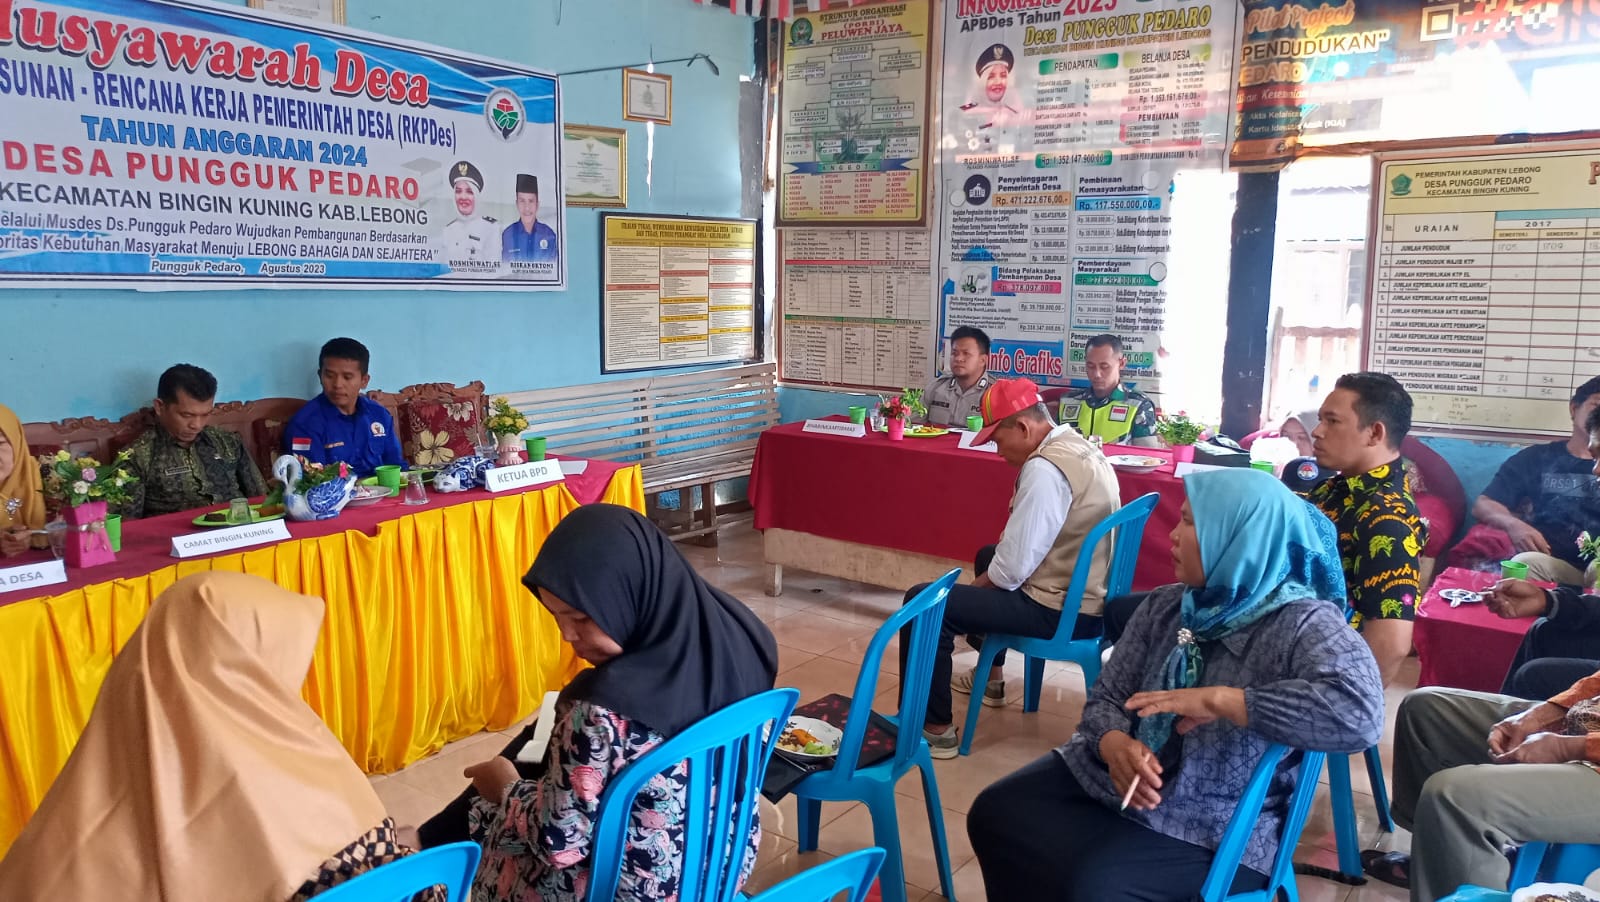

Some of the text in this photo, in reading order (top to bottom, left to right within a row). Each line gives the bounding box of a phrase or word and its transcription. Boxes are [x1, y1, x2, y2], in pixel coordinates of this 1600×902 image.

[820, 9, 858, 21] STRUKTUR
[859, 4, 906, 17] ORGANISASI
[1248, 1, 1355, 36] Pilot Project
[960, 11, 1061, 33] APBDes Tahun
[1024, 5, 1212, 46] Desa PUNGGUK PEDARO
[821, 27, 872, 40] PELUWEN
[875, 23, 903, 34] JAYA
[1054, 58, 1098, 71] PENDAPATAN
[1142, 50, 1190, 63] BELANJA DESA
[332, 49, 430, 106] Desa
[93, 72, 187, 115] RENCANA
[191, 85, 249, 122] KERJA
[253, 94, 353, 137] PEMERINTAH
[358, 108, 394, 140] DESA
[398, 112, 456, 155] (RKPDes)
[1138, 112, 1179, 121] PEMBIAYAAN
[81, 115, 367, 167] TAHUN ANGGARAN 2024
[3, 141, 419, 200] DESA PUNGGUK PEDARO
[1463, 168, 1507, 176] KABUPATEN
[1509, 166, 1541, 174] LEBONG
[998, 184, 1040, 192] Pemerintah
[1079, 176, 1122, 184] Pembinaan
[1425, 176, 1532, 188] DESA PUNGGUK PEDARO
[1079, 185, 1144, 194] Kemasyarakatan
[1427, 188, 1470, 196] KECAMATAN
[0, 181, 428, 225] KECAMATAN BINGIN KUNING KAB.LEBONG
[46, 213, 101, 230] Musdes
[107, 216, 185, 237] Ds.Pungguk
[190, 221, 231, 236] Pedaro
[236, 223, 290, 240] Wujudkan
[294, 226, 366, 244] Pembangunan
[369, 231, 427, 244] Berdasarkan
[43, 235, 120, 251] Kebutuhan
[124, 238, 197, 256] Masyarakat
[201, 240, 244, 258] Menuju
[248, 242, 297, 257] LEBONG
[300, 245, 349, 258] BAHAGIA
[352, 247, 374, 260] DAN
[152, 260, 325, 274] Pungguk Pedaro, Agustus 2023
[1015, 349, 1062, 376] Grafiks
[497, 466, 548, 484] KETUA BPD
[183, 527, 274, 549] CAMAT BINGIN KUNING
[12, 571, 44, 585] DESA
